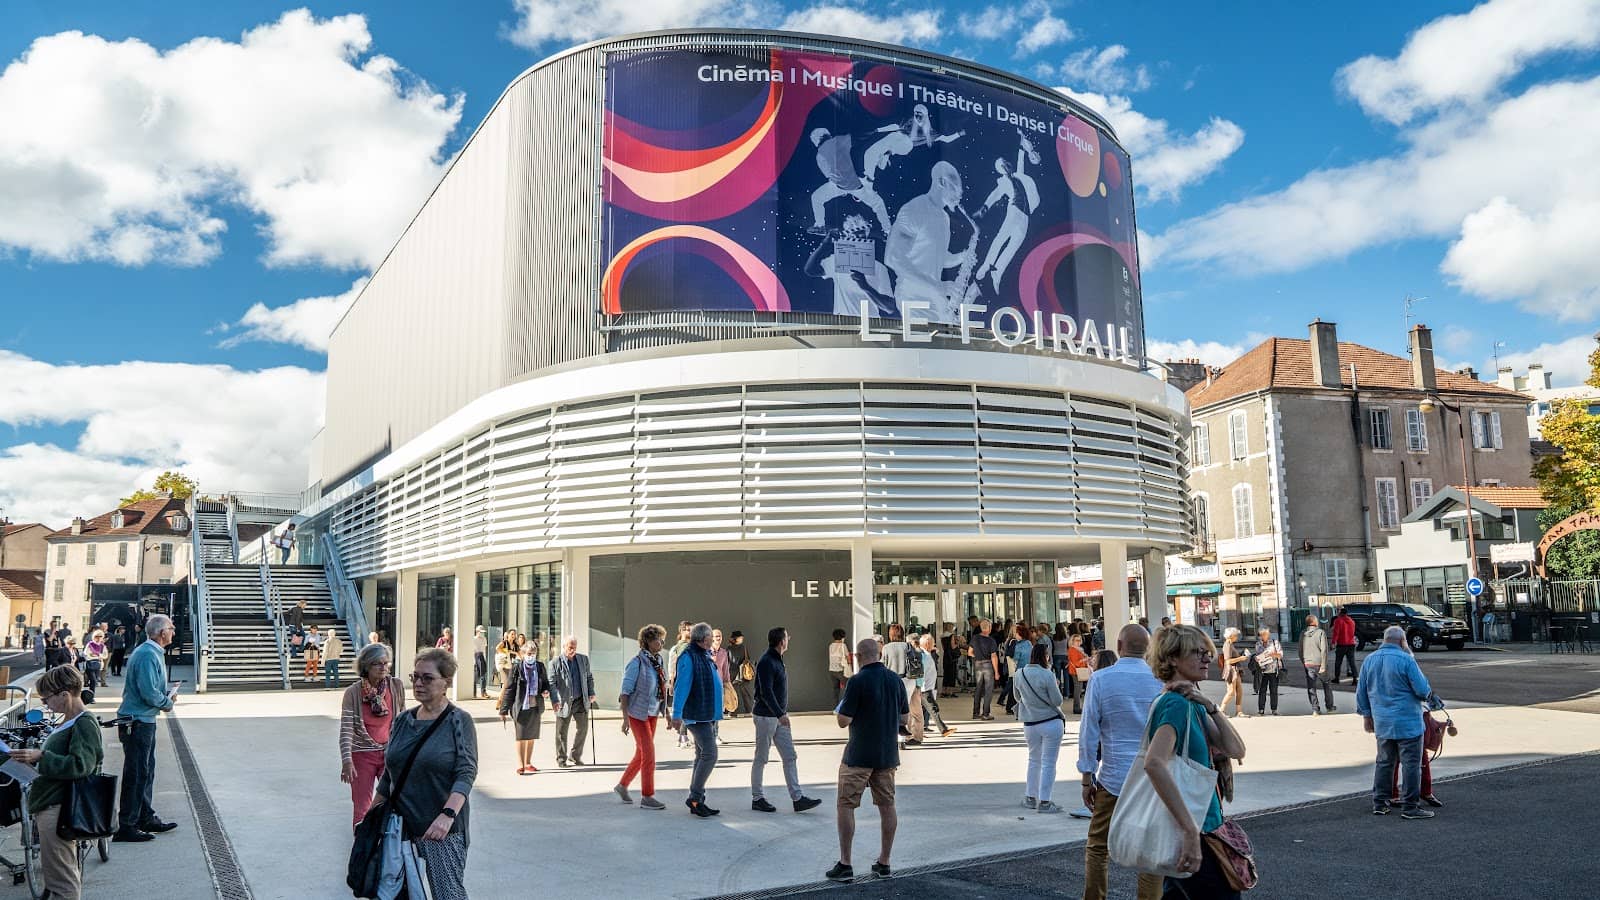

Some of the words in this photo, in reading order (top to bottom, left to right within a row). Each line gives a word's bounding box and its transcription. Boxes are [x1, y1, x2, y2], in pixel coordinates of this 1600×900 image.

[803, 69, 893, 97] Musique
[997, 106, 1046, 134] Danse
[1058, 126, 1095, 156] Cirque
[860, 300, 933, 342] LE
[960, 303, 1139, 366] FOIRAIL
[1541, 526, 1565, 545] TAM
[1224, 564, 1247, 577] CAFÉS
[1251, 566, 1269, 575] MAX
[791, 580, 819, 597] LE
